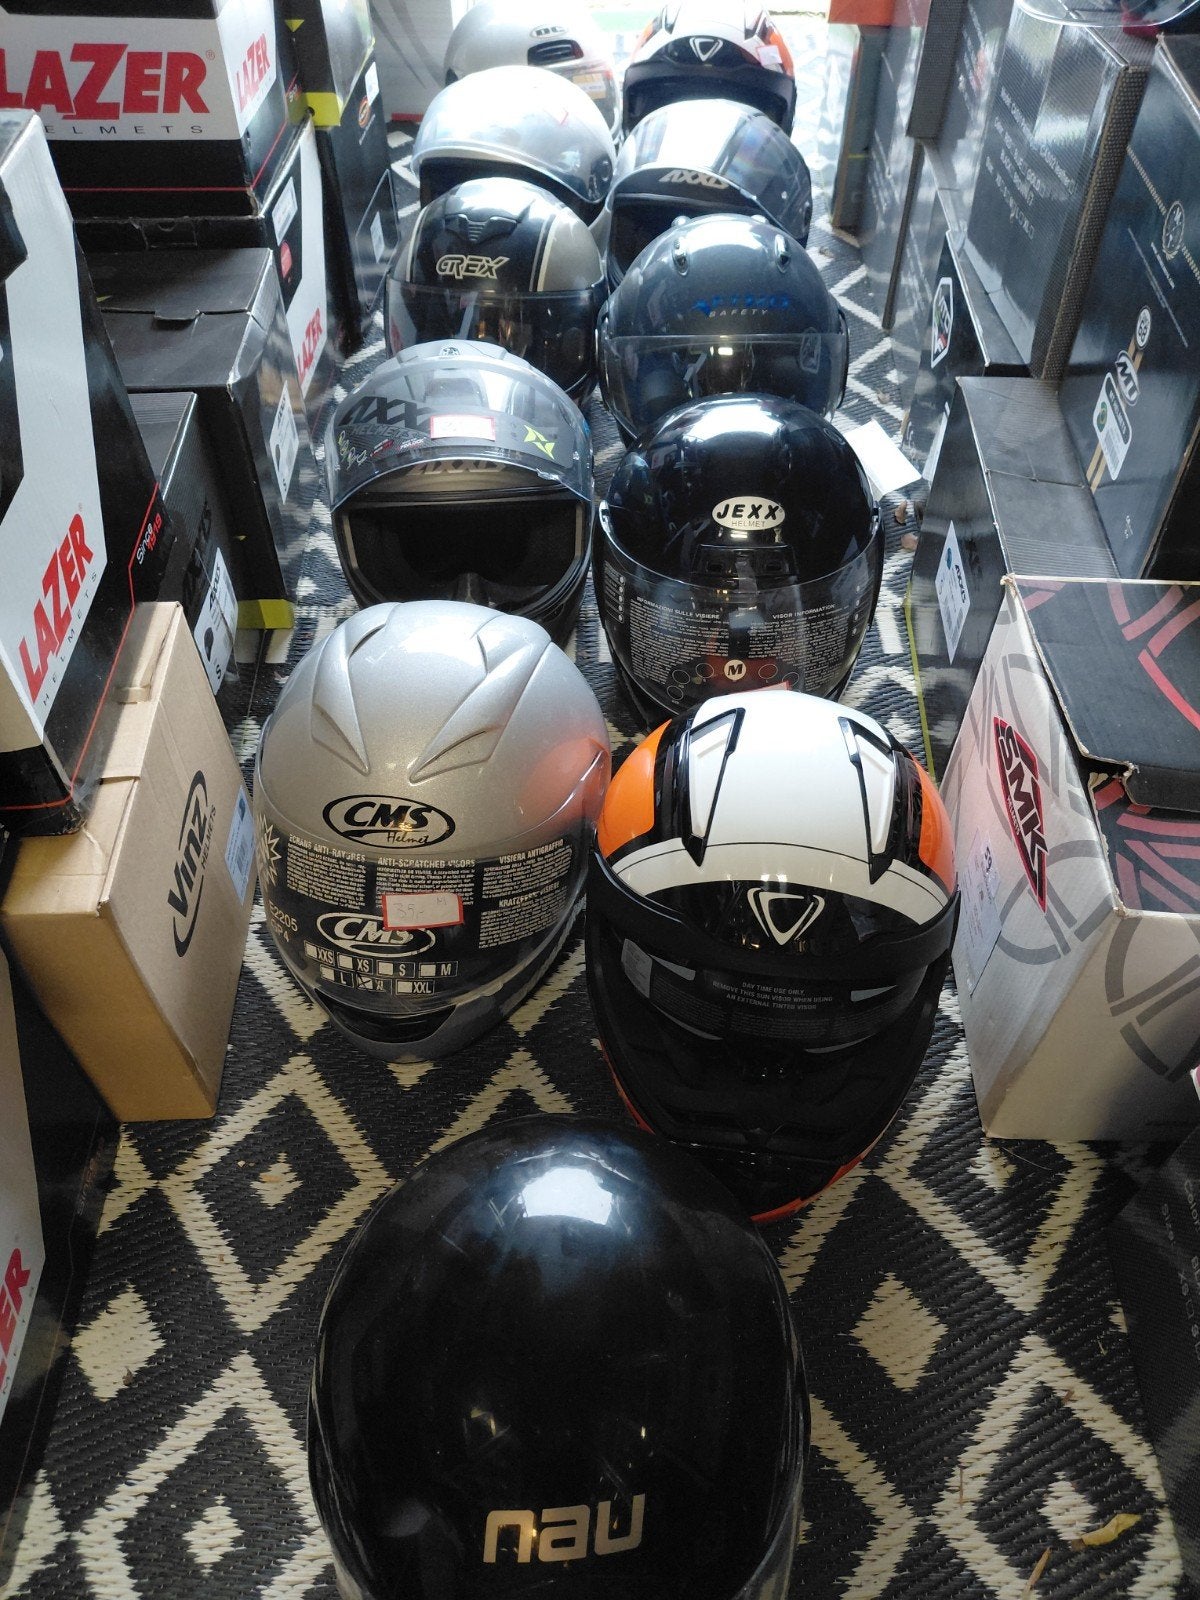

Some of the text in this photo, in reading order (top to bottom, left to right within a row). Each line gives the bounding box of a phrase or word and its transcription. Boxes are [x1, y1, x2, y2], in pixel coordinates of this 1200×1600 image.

[236, 33, 271, 113] LAZER
[44, 124, 203, 135] ELMETS
[716, 503, 779, 520] JEXX
[732, 520, 765, 528] HELMET
[137, 522, 152, 566] Since
[18, 513, 93, 705] LAZER
[695, 612, 720, 620] VISIERE
[772, 603, 835, 620] VISOR INFORMATION
[727, 663, 744, 676] M
[1000, 725, 1048, 868] SMK
[343, 801, 432, 829] CMS
[201, 804, 216, 870] HELMETS
[387, 831, 430, 844] Helmet
[499, 852, 526, 864] VISIERA
[317, 949, 334, 964] XXS
[356, 958, 369, 973] XS
[399, 964, 406, 976] S
[440, 963, 452, 976] M
[340, 972, 347, 985] L
[412, 980, 432, 994] XXL
[712, 980, 738, 993] REMOVE
[740, 989, 755, 998] THIS
[483, 1493, 645, 1564] nau
